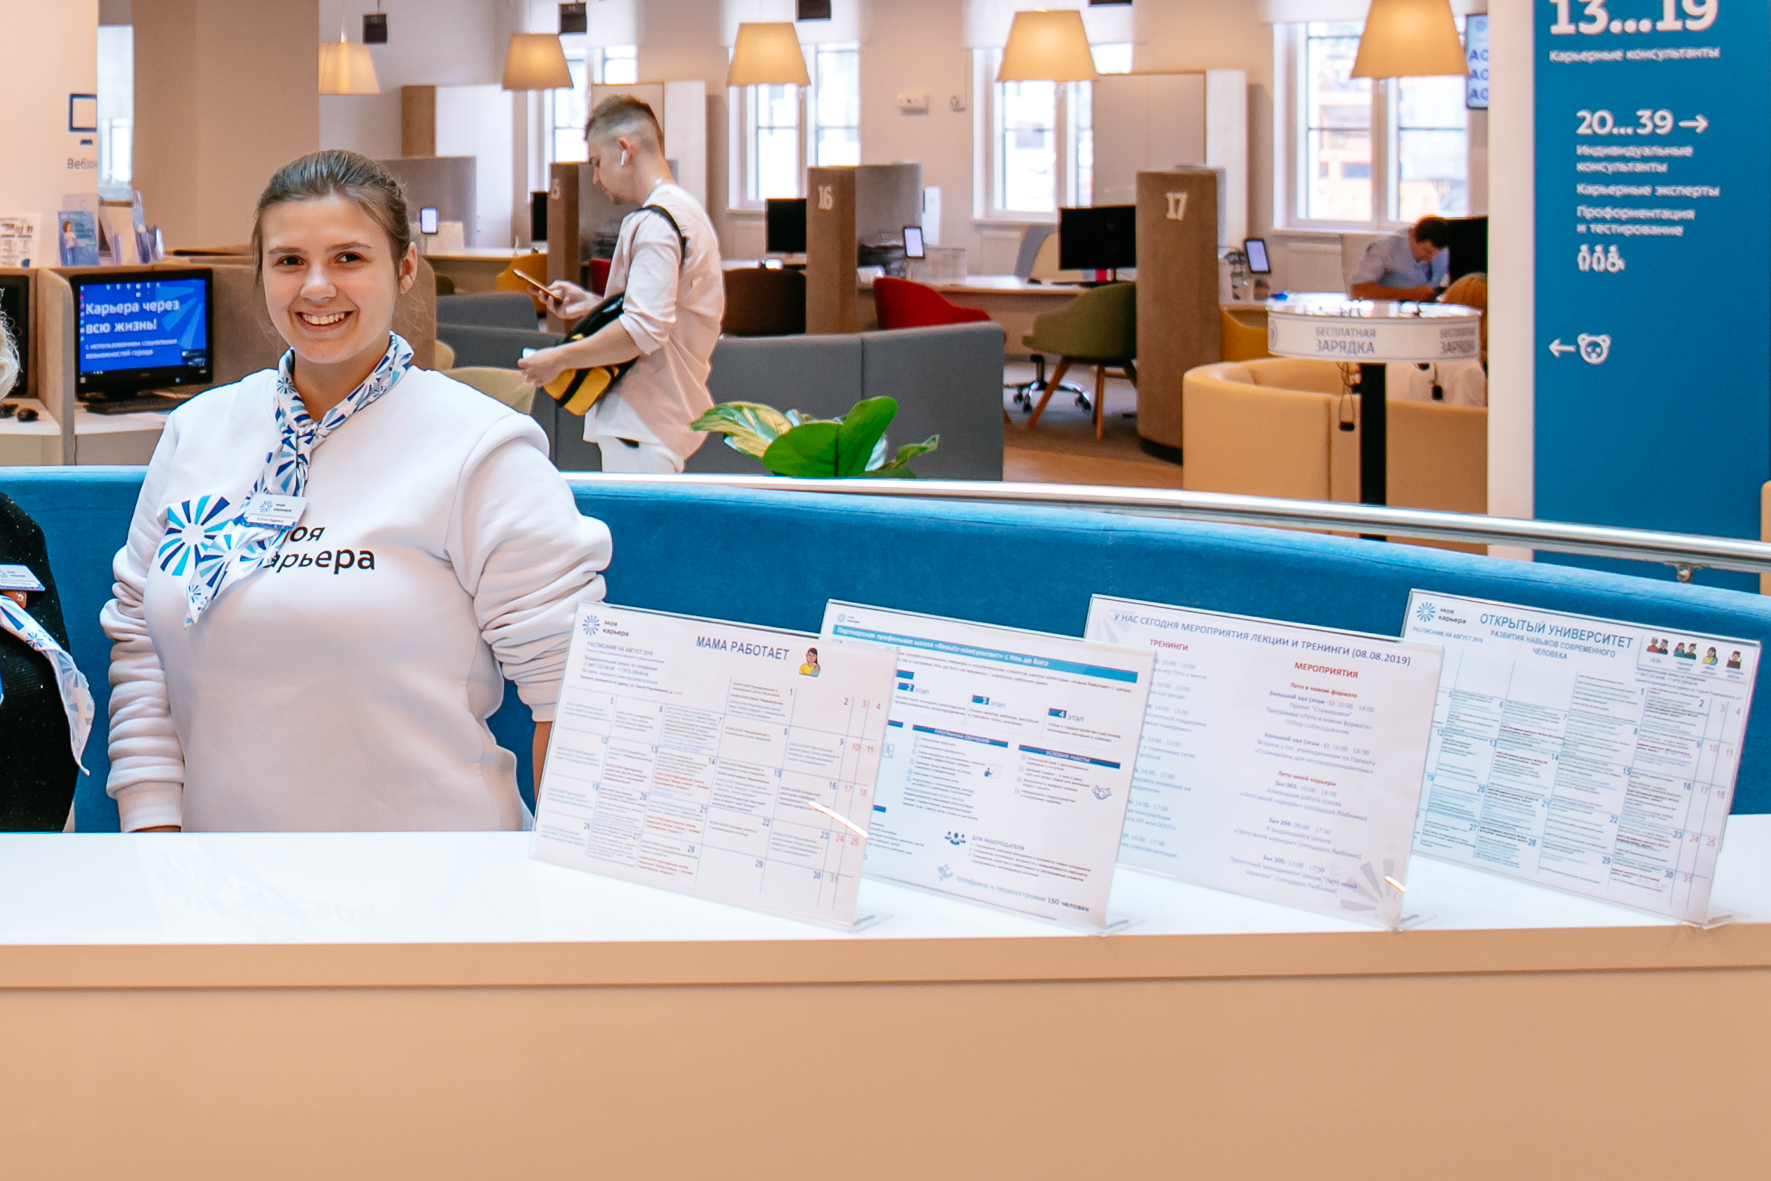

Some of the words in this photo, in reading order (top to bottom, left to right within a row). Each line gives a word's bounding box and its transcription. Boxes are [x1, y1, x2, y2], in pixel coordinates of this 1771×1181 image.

[1549, 49, 1623, 63] Карьерные
[1626, 46, 1720, 61] консультанты
[1576, 109, 1674, 135] 20...39
[1577, 144, 1694, 159] Индивидуальные
[1577, 160, 1668, 175] консультанты
[818, 185, 833, 210] 16
[1577, 183, 1652, 198] Карьерные
[1655, 184, 1720, 199] эксперты
[1166, 192, 1188, 221] 17
[1577, 205, 1695, 221] Профориентация
[1577, 225, 1587, 236] и
[1589, 223, 1684, 238] тестирование
[85, 302, 140, 318] Карьера
[143, 300, 180, 313] через
[85, 323, 111, 334] всю
[114, 318, 157, 332] жизнь!
[1315, 326, 1376, 338] БЕСПЛАТНАЯ
[1315, 340, 1375, 355] ЗАРЯДКА
[283, 526, 325, 543] оя
[263, 549, 375, 575] арьера
[1480, 613, 1546, 635] ОТКРЫТЫЙ
[1548, 624, 1633, 649] УНИВЕРСИТЕТ
[696, 636, 727, 652] МАМА
[730, 641, 790, 661] РАБОТАЕТ
[1121, 614, 1138, 624] НАС
[1140, 617, 1179, 630] СЕГОДНЯ
[1181, 623, 1248, 640] МЕРОПРИЯТИЯ
[1250, 633, 1289, 647] ЛЕКЦИИ
[1301, 641, 1350, 656] ТРЕНИНГИ
[1352, 648, 1411, 666] (08.08.2019)
[1150, 639, 1188, 651] ТРЕНИНГИ
[1490, 630, 1525, 642] РАЗВИТИЯ
[1526, 636, 1559, 648] НАВЫКОВ
[1560, 642, 1616, 658] СОВРЕМЕННОГО
[1533, 647, 1568, 660] ЧЕЛОВЕКА
[1294, 662, 1358, 678] МЕРОПРИЯТИЯ
[1290, 682, 1304, 690] Лето
[1331, 689, 1358, 699] формате
